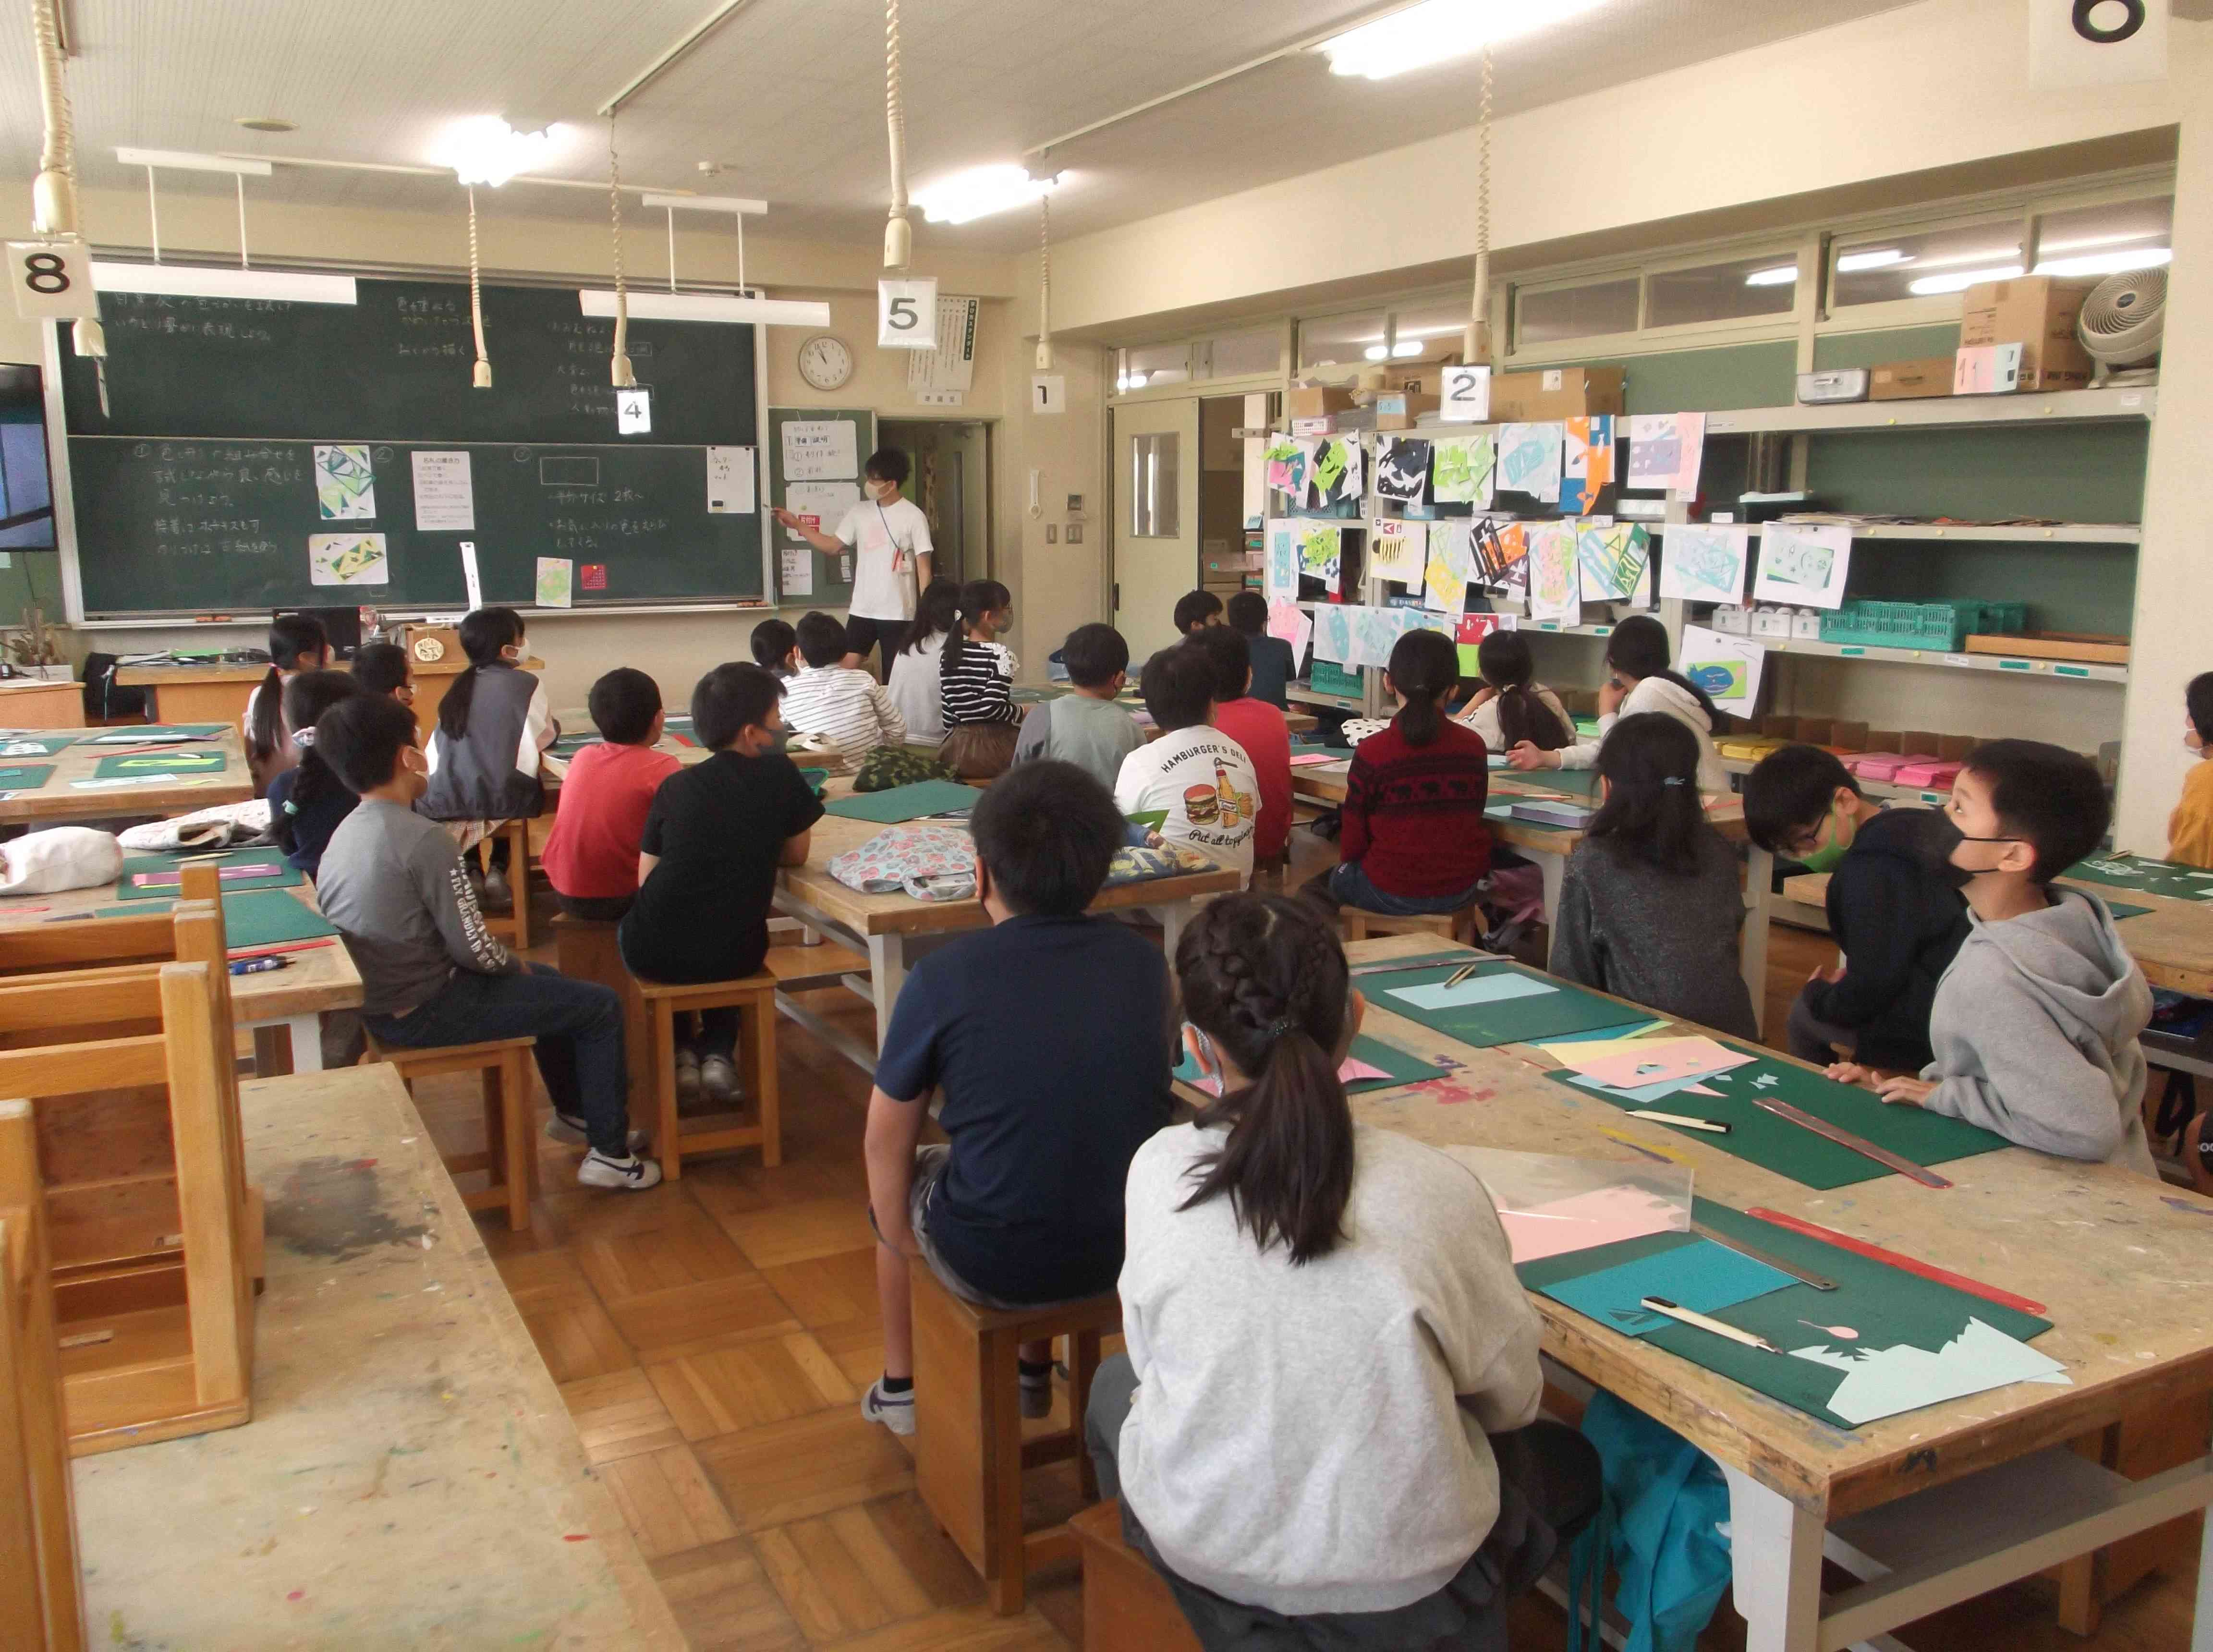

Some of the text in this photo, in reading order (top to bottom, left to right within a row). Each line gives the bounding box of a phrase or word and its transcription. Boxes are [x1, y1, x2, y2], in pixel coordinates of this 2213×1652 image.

[24, 253, 71, 294] 8
[888, 297, 918, 330] 5
[1037, 385, 1048, 405] 1
[1451, 374, 1476, 401] 2
[623, 401, 643, 420] 4
[1161, 744, 1246, 773] HAMBURGER'S DELI
[1189, 829, 1210, 843] Put
[1211, 834, 1223, 845] all
[451, 876, 463, 895] FLY
